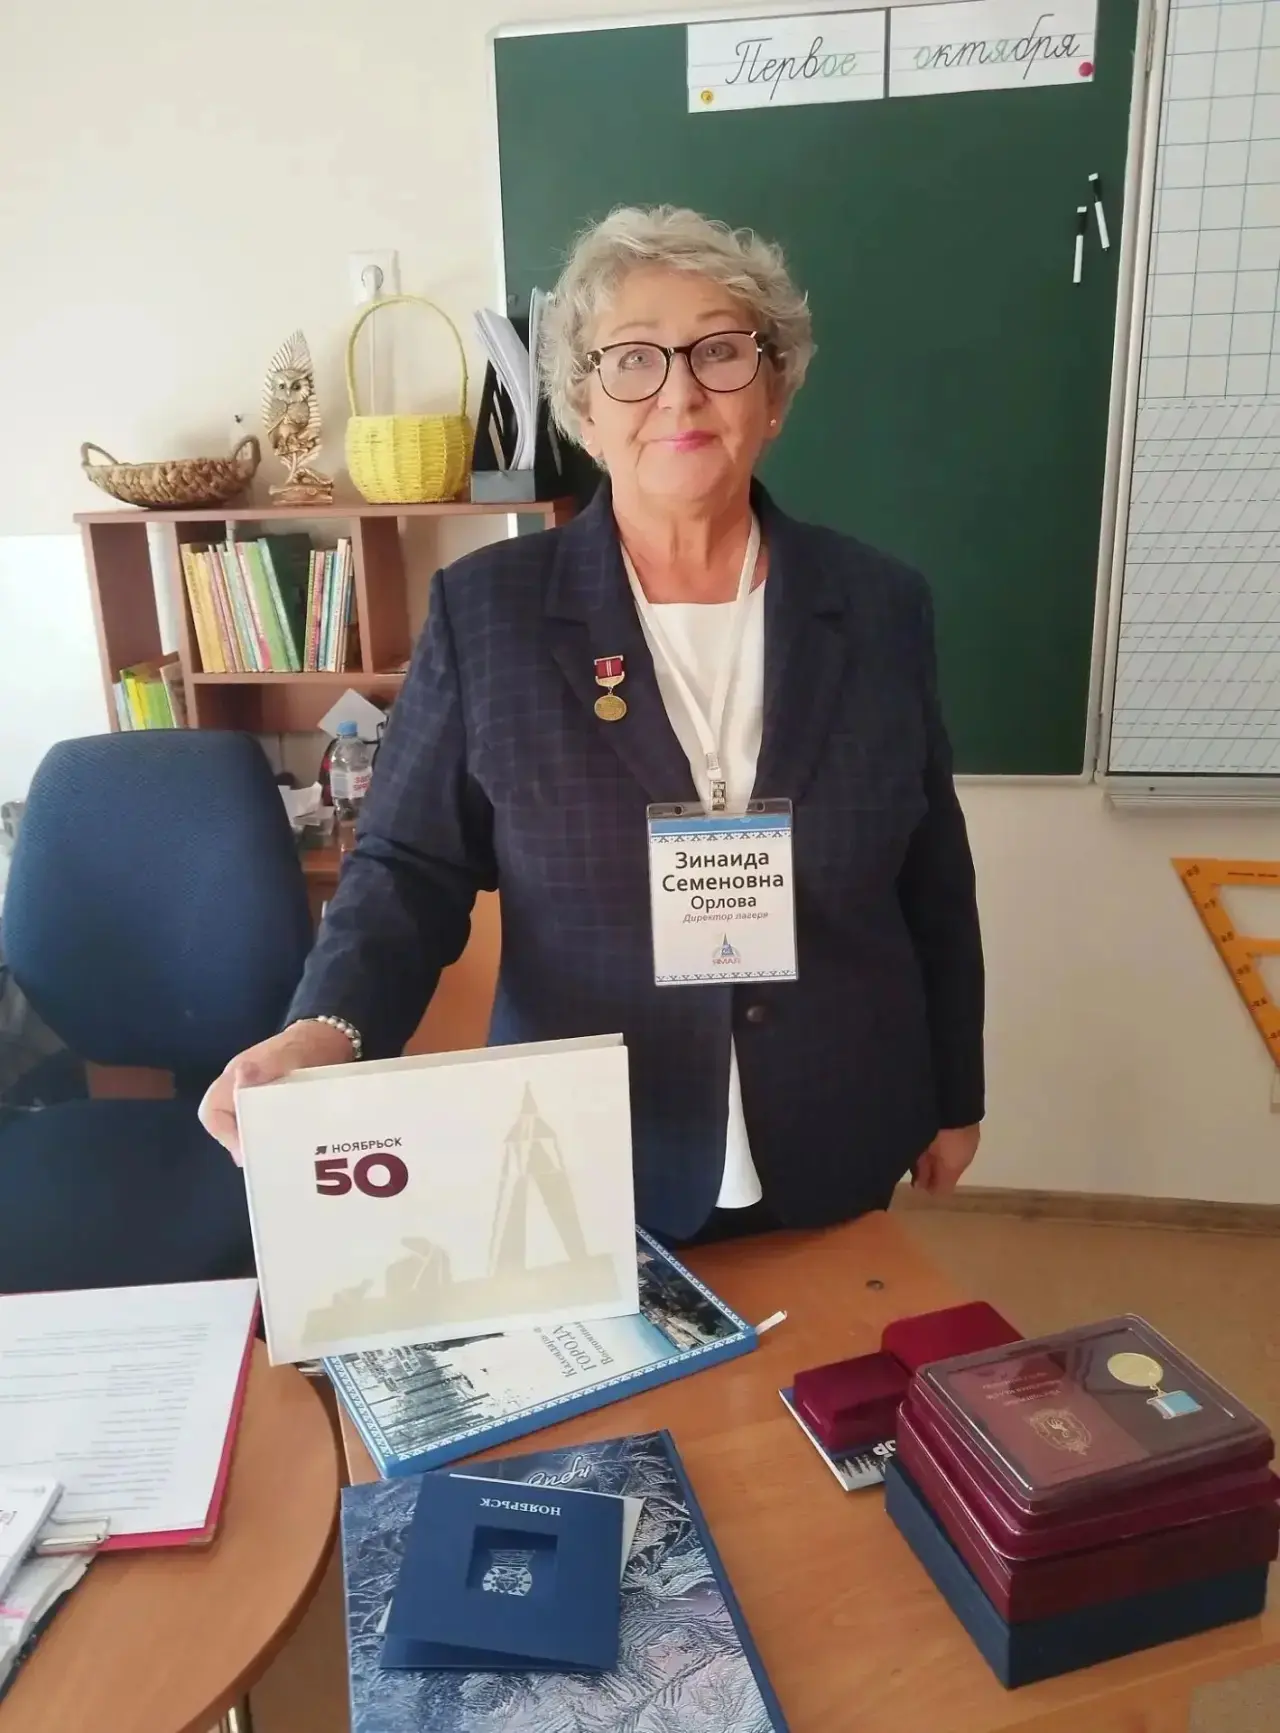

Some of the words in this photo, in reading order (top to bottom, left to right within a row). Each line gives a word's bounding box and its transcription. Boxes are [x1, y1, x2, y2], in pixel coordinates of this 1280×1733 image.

[725, 36, 857, 100] Первое
[913, 13, 1082, 80] октября
[675, 851, 770, 870] Зинаида
[662, 873, 784, 892] Семеновна
[691, 896, 757, 913] Орлова
[683, 913, 733, 924] Директор
[332, 1137, 403, 1153] НОЯБРЬСК
[314, 1152, 409, 1198] 50
[552, 1325, 597, 1371] ГОРОДА
[478, 1497, 562, 1517] НОЯБРЬСК
